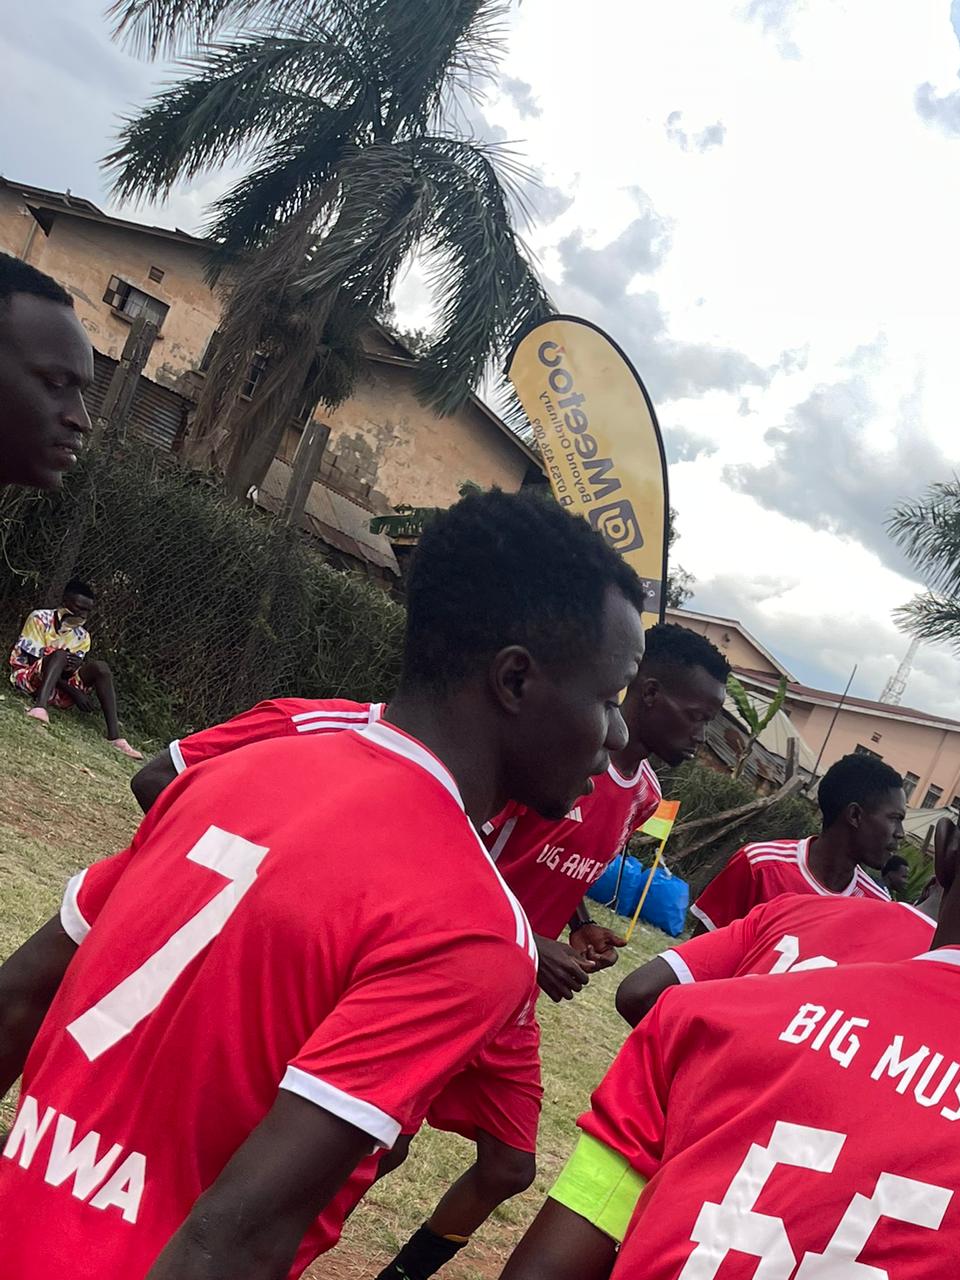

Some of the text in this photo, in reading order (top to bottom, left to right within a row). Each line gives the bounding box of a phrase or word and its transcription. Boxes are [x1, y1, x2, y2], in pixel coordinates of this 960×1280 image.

[536, 844, 604, 883] UG ANFI
[66, 825, 270, 1061] 7
[768, 934, 838, 974] 1
[779, 1002, 869, 1068] BIG
